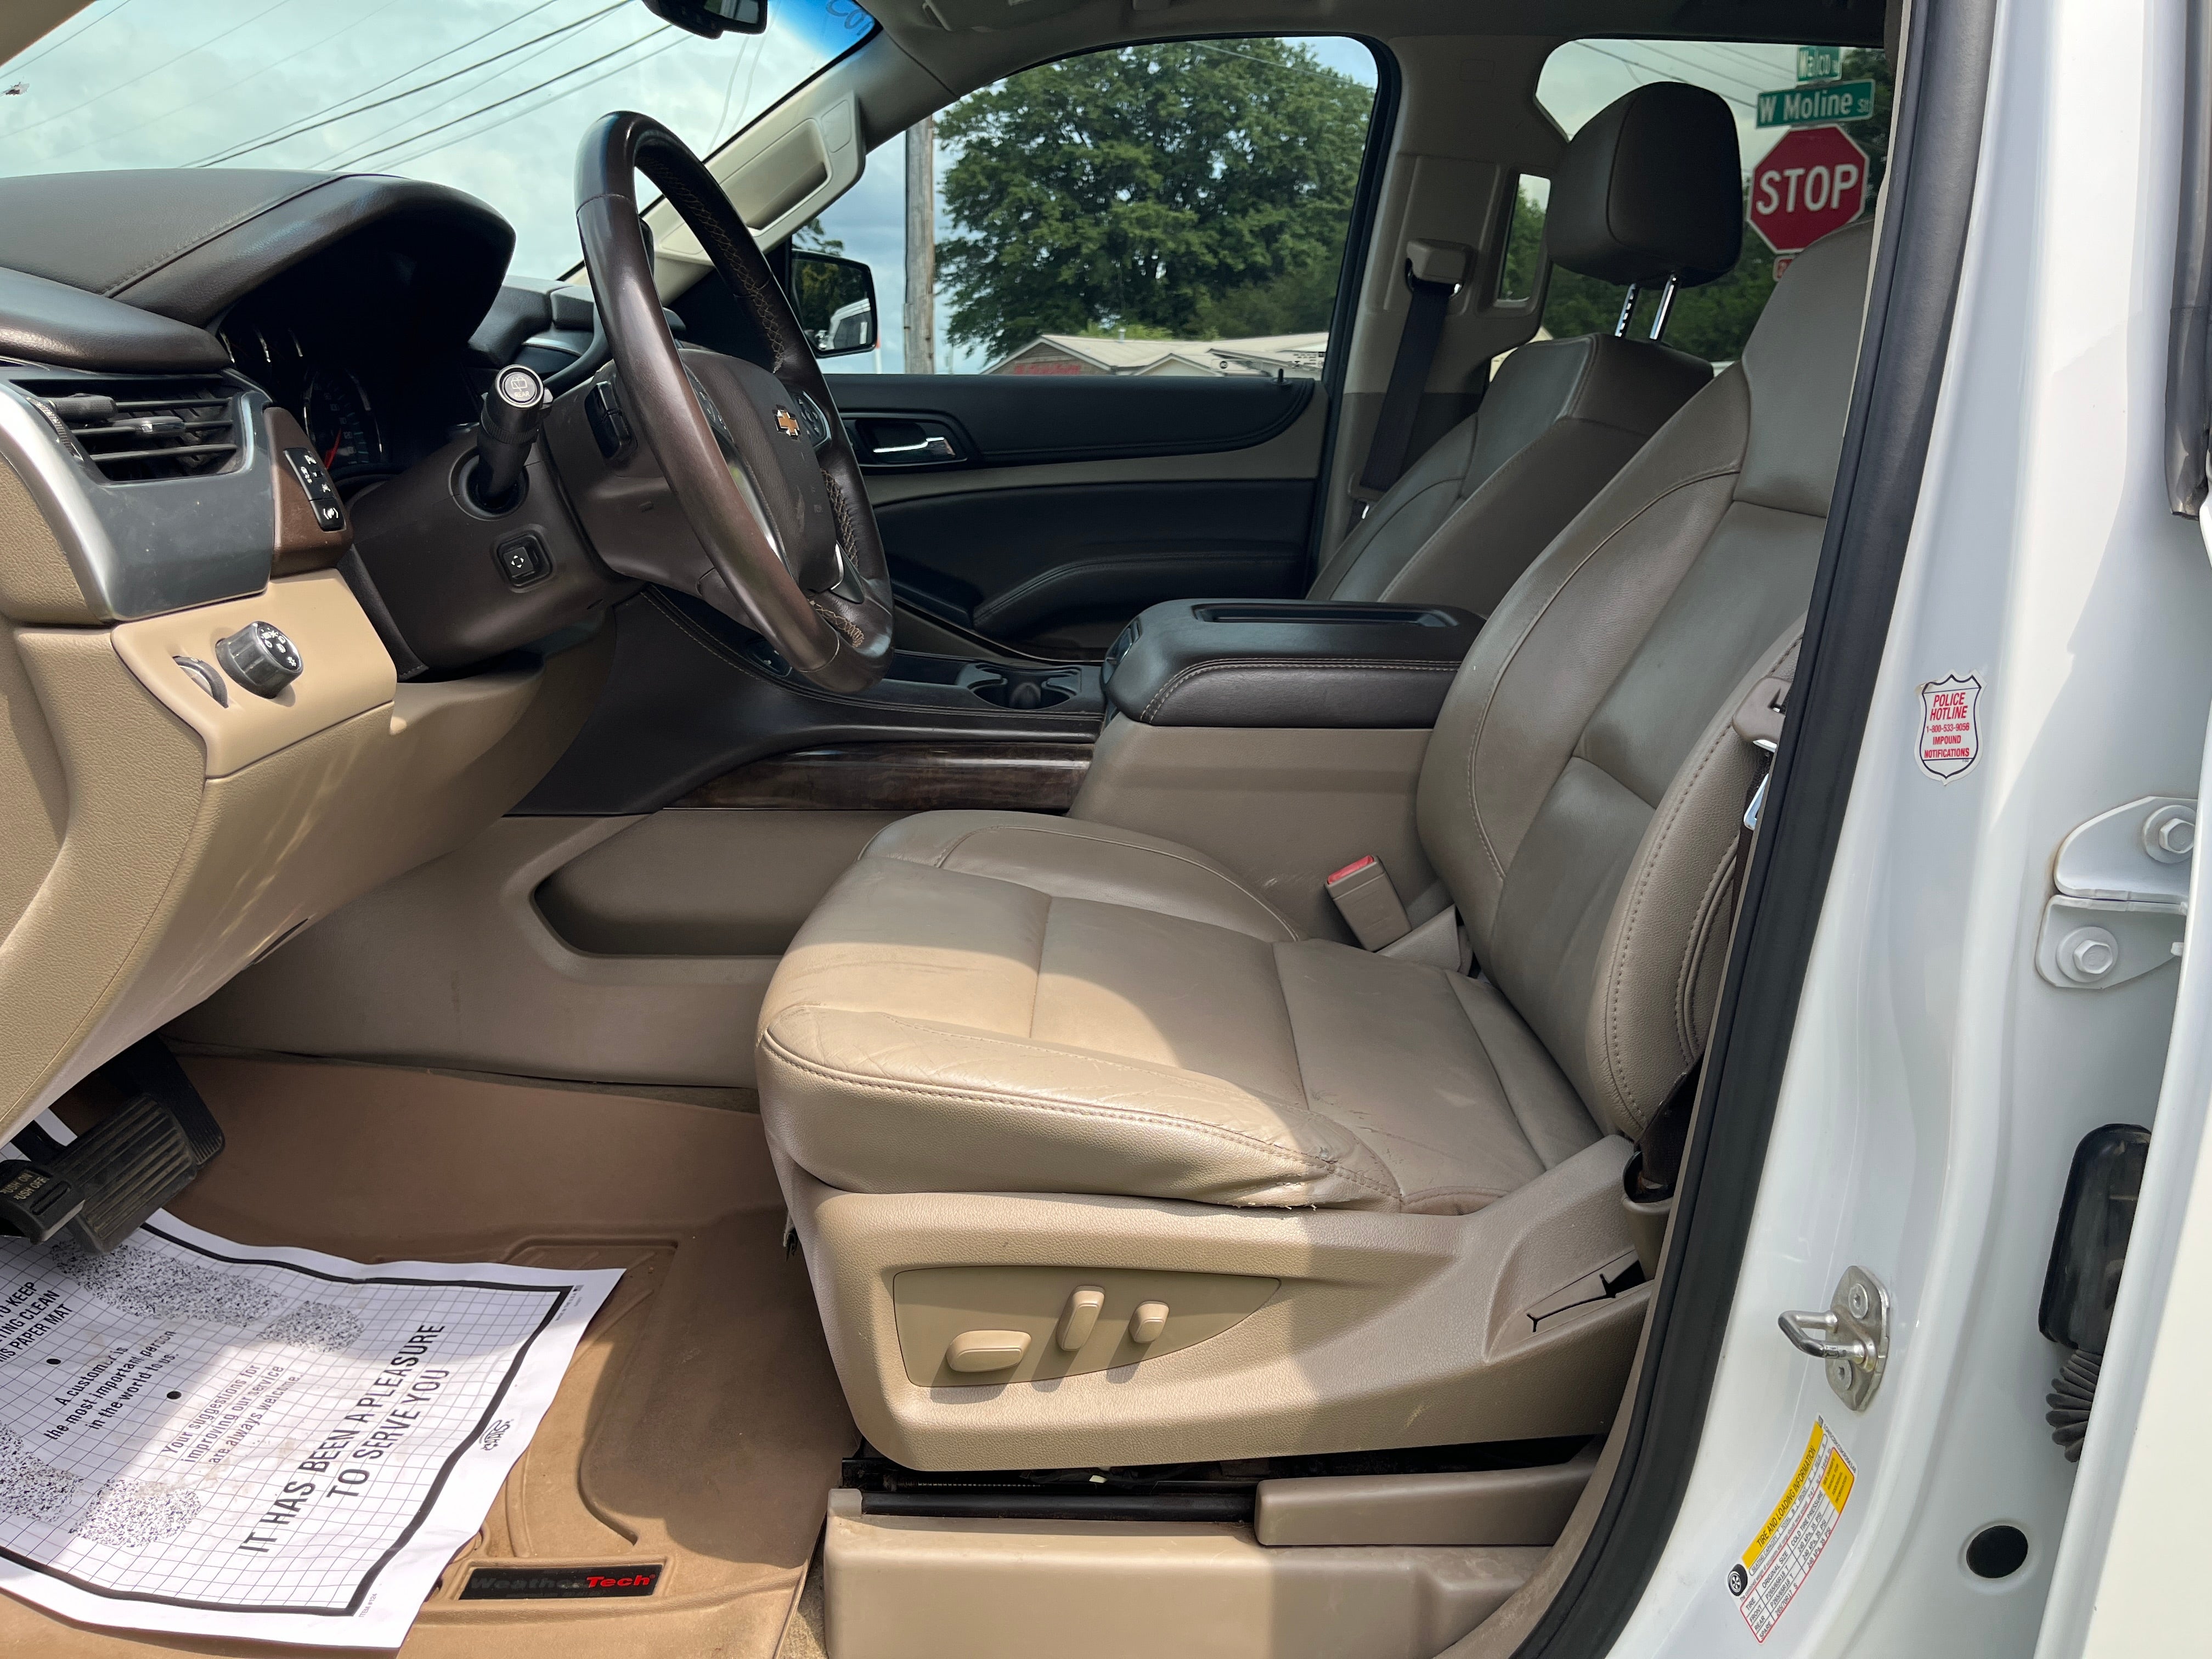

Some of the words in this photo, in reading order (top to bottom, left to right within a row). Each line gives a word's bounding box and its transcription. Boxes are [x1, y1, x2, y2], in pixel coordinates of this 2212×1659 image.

[1759, 95, 1778, 123] W
[1784, 89, 1853, 121] Moline
[1756, 165, 1858, 215] STOP
[1929, 705, 1968, 721] HOTLINE
[1933, 692, 1966, 708] POLICE
[1924, 748, 1970, 758] NOTIFICATIONS
[1932, 735, 1961, 745] IMPOUND
[5, 1282, 37, 1306] KEEP
[19, 1290, 60, 1320] CLEAN
[9, 1323, 51, 1350] PAPER
[44, 1304, 72, 1325] MAT
[44, 1425, 69, 1440] the
[65, 1398, 97, 1424] most
[88, 1356, 145, 1399] important
[140, 1330, 177, 1358] person
[356, 1324, 445, 1408] PLEASURE
[55, 1397, 71, 1406] A
[85, 1419, 105, 1430] in
[98, 1401, 123, 1418] the
[119, 1372, 152, 1401] world
[145, 1363, 163, 1372] to
[159, 1353, 179, 1364] us.
[161, 1431, 193, 1454] Your
[189, 1379, 247, 1430] suggestions
[239, 1364, 261, 1378] for
[180, 1413, 239, 1463] improving
[232, 1396, 252, 1412] our
[247, 1366, 284, 1396] service
[208, 1448, 230, 1463] are
[225, 1412, 263, 1446] always
[257, 1374, 303, 1410] welcome.
[326, 1469, 370, 1497] TO
[352, 1409, 421, 1460] SERVE
[401, 1370, 450, 1404] YOU
[344, 1413, 375, 1424] A
[298, 1429, 361, 1473] BEEN
[259, 1481, 316, 1525] HAS
[1757, 1531, 1769, 1548] TIRE
[1767, 1517, 1778, 1534] AND
[1776, 1489, 1795, 1520] LOADING
[1792, 1444, 1816, 1491] INFORMATION
[239, 1531, 278, 1553] IT
[1746, 1597, 1756, 1611] TIRE
[1762, 1564, 1780, 1589] ORIGINAL
[1779, 1550, 1788, 1565] SIZE
[1791, 1530, 1801, 1547] COLD
[1800, 1517, 1809, 1531] TIRE
[1807, 1489, 1824, 1519] PRESSURE
[1750, 1604, 1762, 1623] FRONT
[1754, 1615, 1766, 1633] REAR
[1759, 1621, 1772, 1639] SPARE
